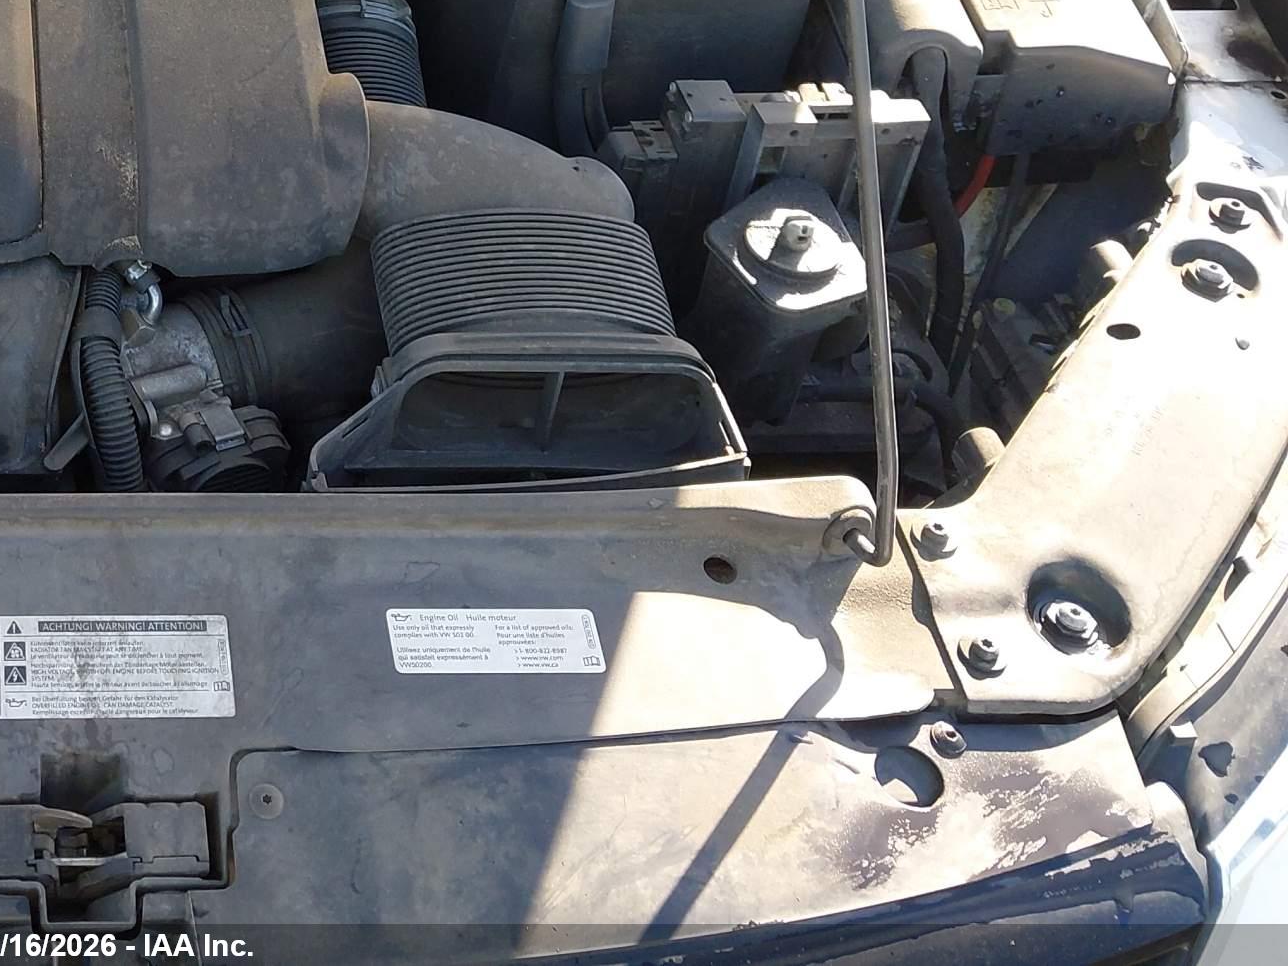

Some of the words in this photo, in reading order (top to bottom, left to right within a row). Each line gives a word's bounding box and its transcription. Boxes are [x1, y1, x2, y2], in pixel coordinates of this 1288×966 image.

[419, 614, 446, 623] Engine
[465, 614, 487, 622] Huile
[42, 622, 92, 632] ACHTUNG!
[95, 622, 145, 632] WARNING!
[148, 622, 203, 632] ATTENTION!
